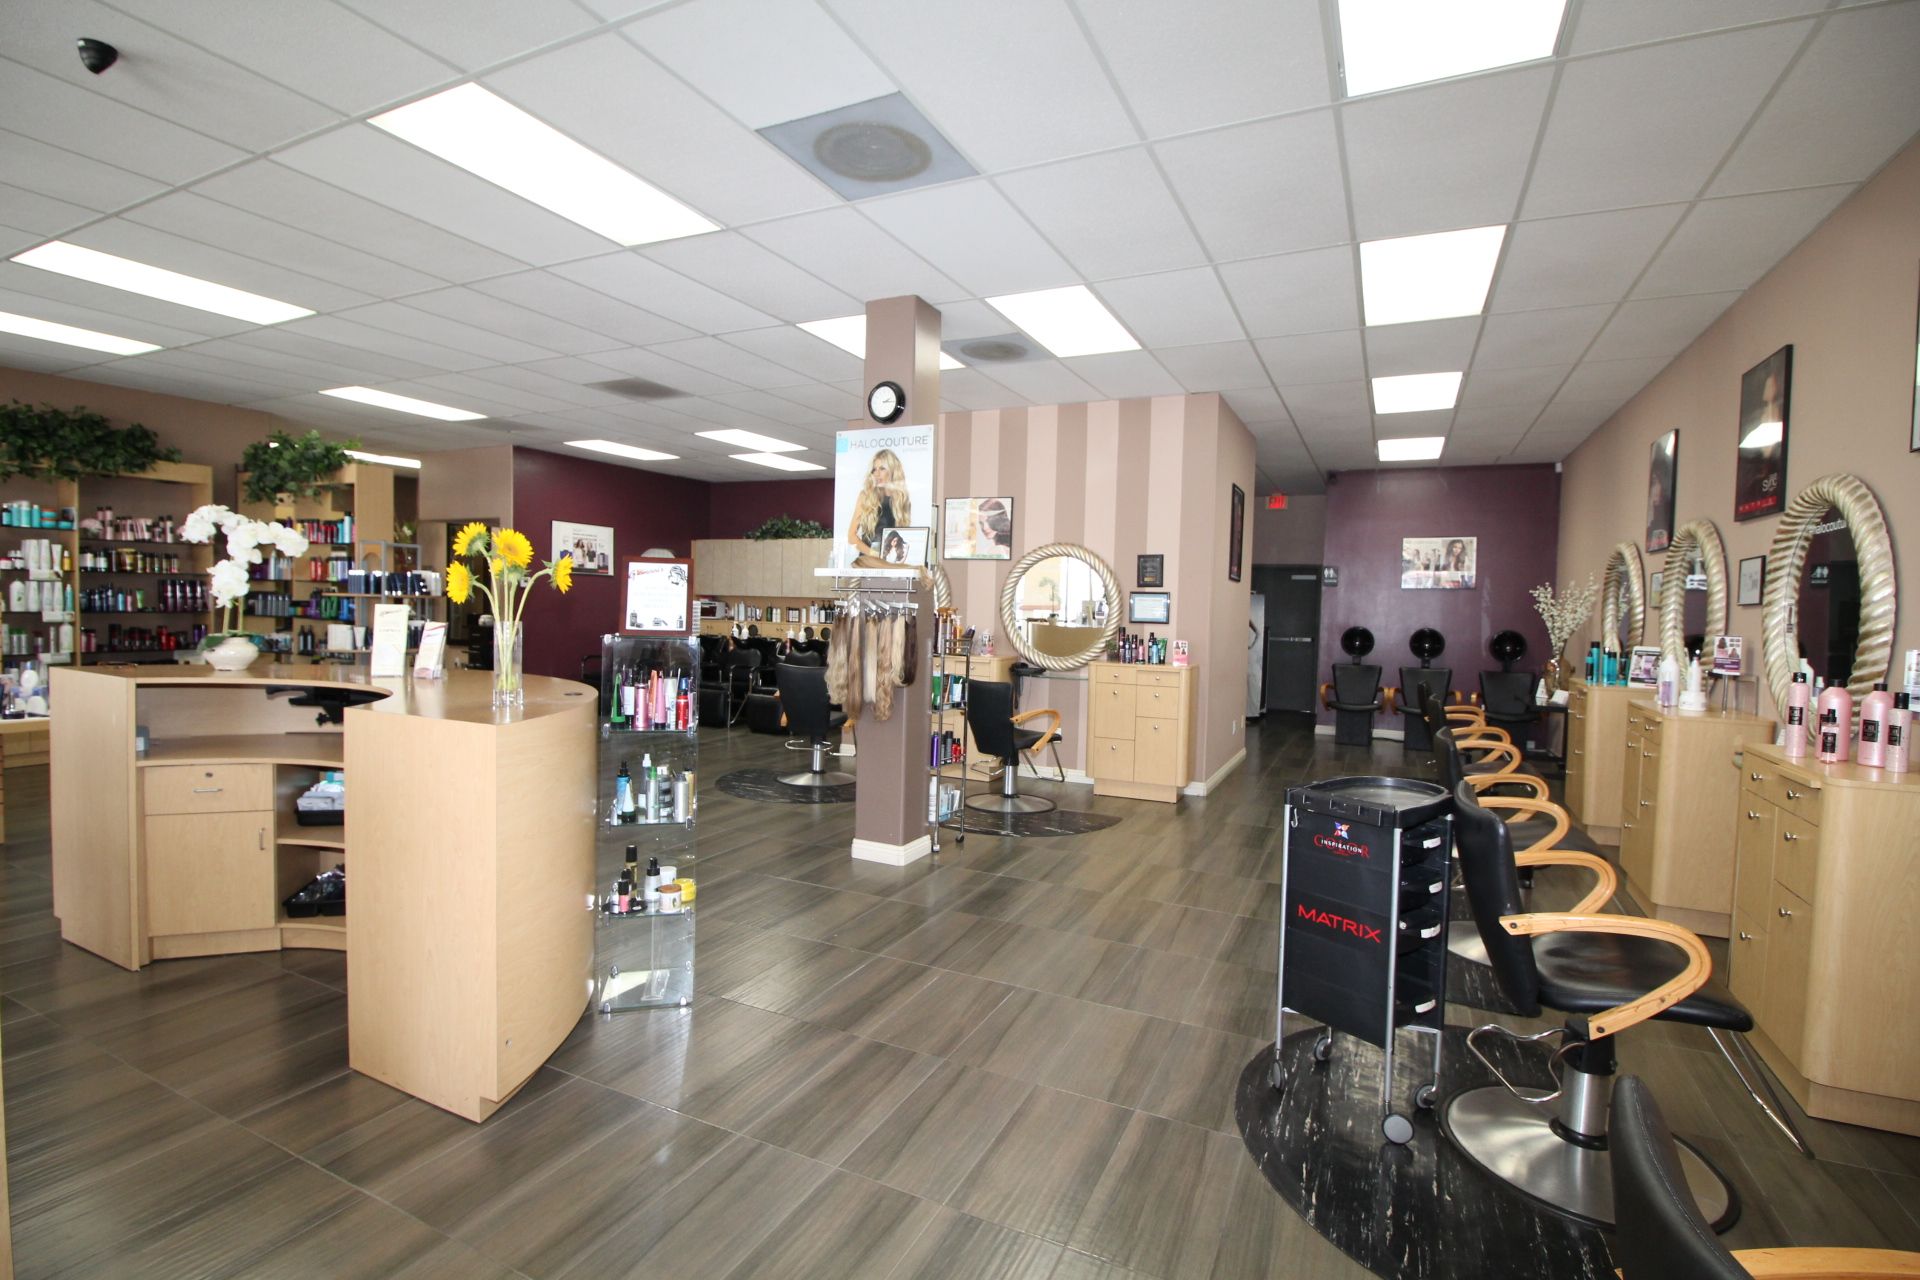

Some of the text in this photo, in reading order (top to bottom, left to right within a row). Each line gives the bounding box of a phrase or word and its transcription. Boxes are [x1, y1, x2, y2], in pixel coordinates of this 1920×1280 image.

[850, 435, 929, 449] HALOCOUTURE
[1320, 838, 1363, 854] INSPIRATION
[1298, 903, 1382, 943] MATRIX
